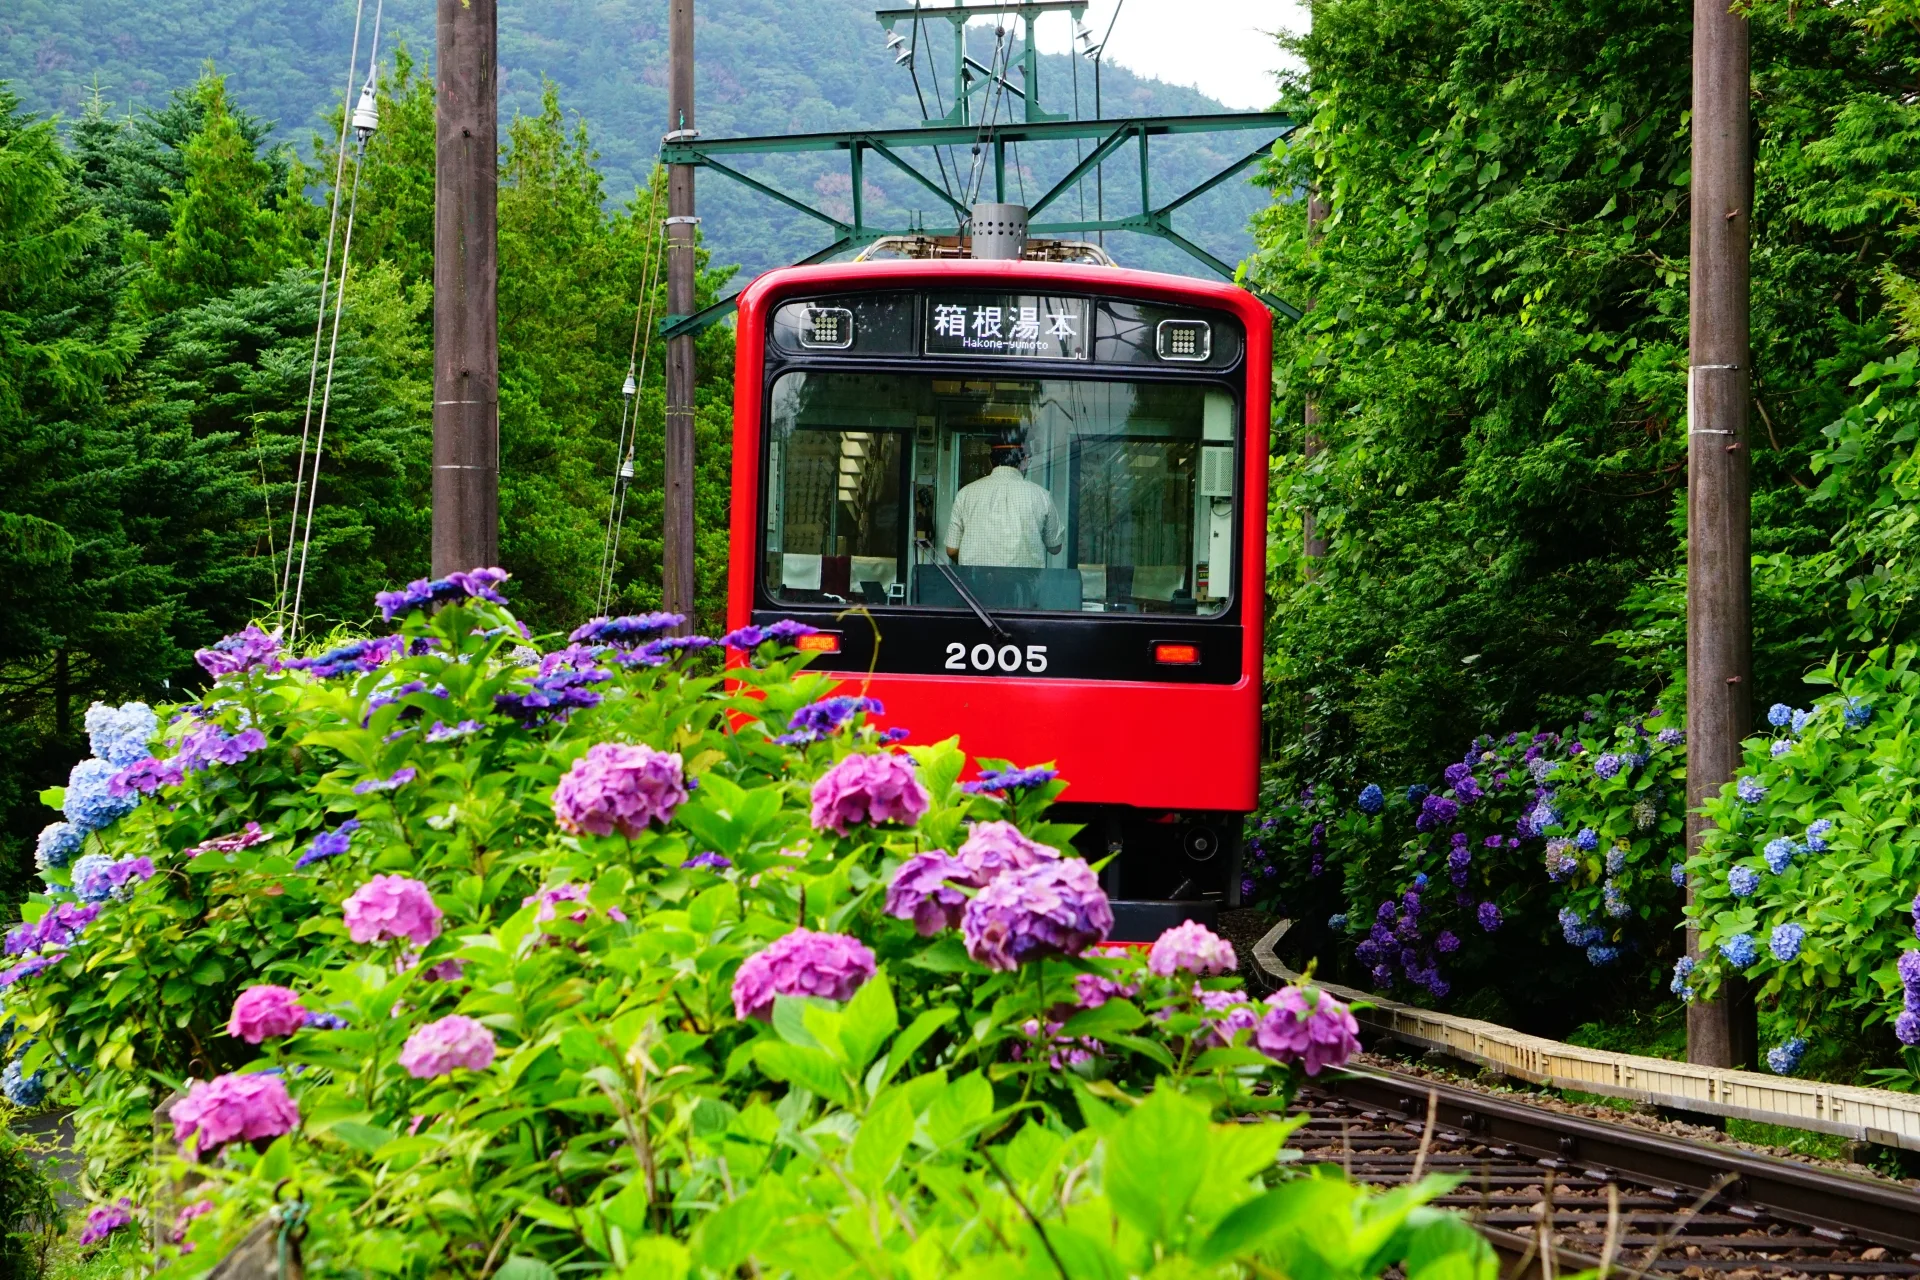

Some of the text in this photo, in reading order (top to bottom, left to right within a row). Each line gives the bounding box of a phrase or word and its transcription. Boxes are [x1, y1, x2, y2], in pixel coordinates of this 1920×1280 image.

[934, 304, 1078, 340] 箱根湯本
[962, 337, 1049, 350] Hakone-yumoto
[945, 642, 1048, 673] 2005
